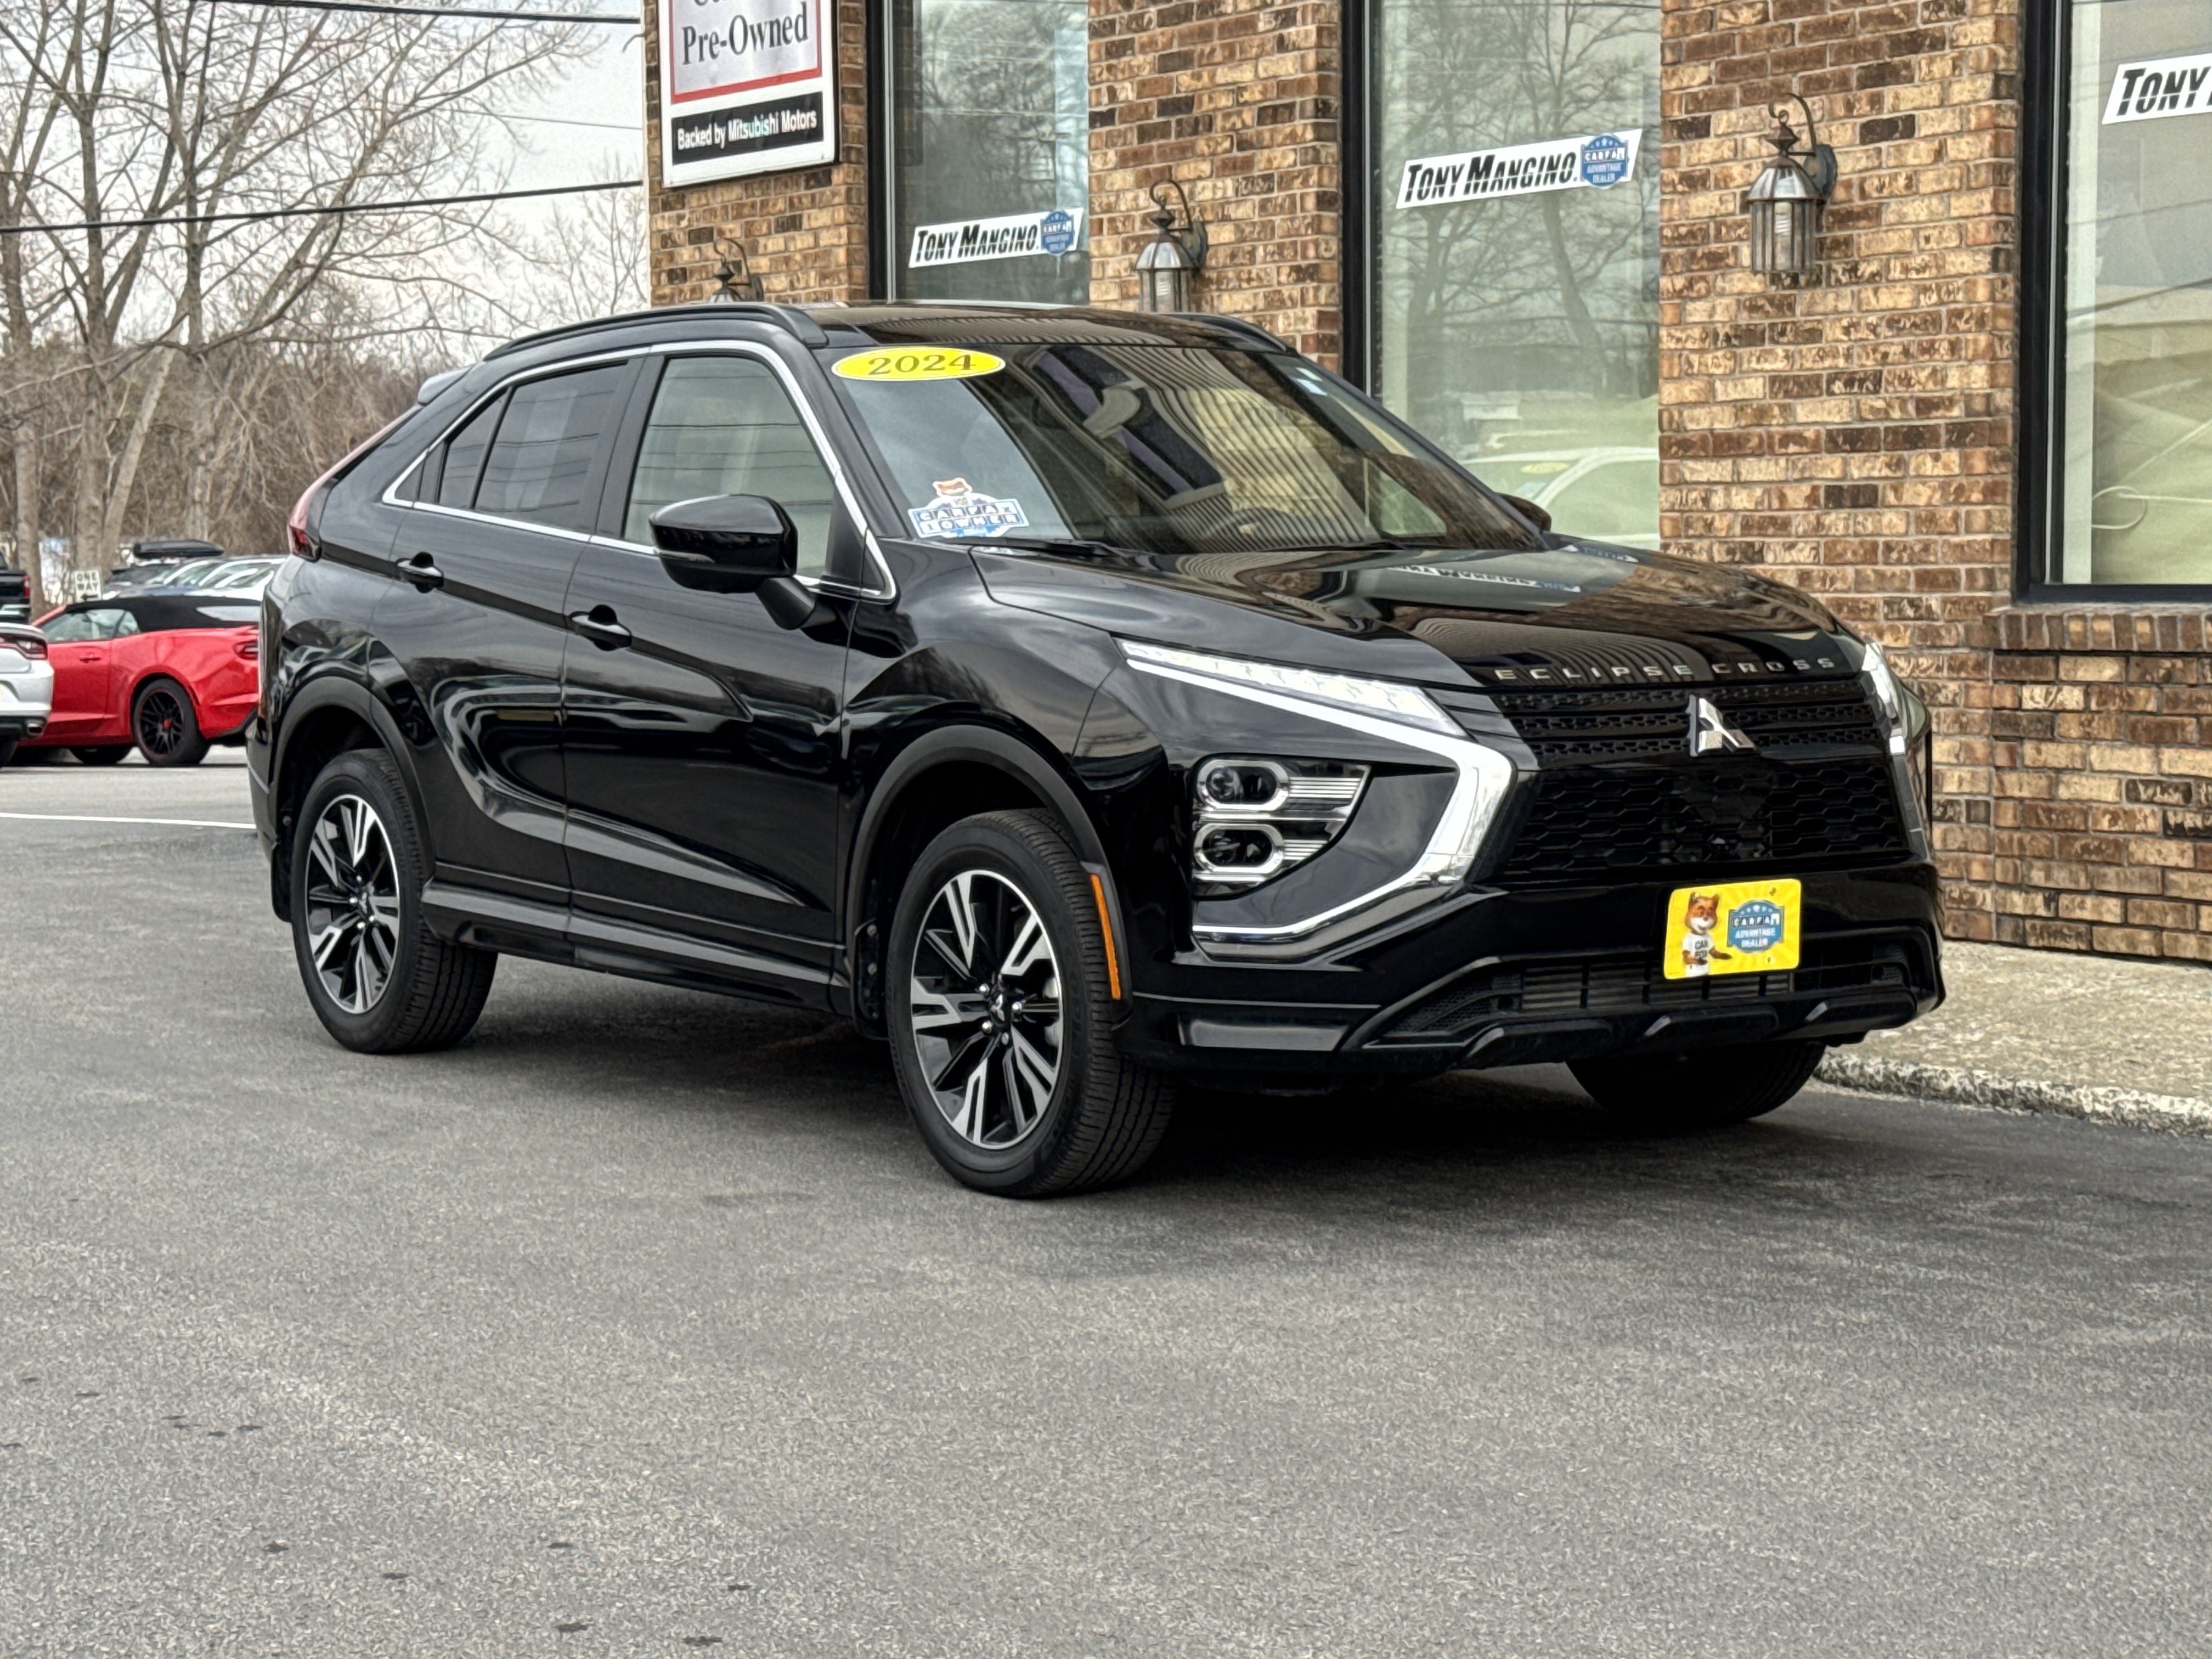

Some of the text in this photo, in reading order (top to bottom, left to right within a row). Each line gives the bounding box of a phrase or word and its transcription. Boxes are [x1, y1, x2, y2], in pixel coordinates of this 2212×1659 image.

[682, 1, 808, 65] Pre-Owned
[2117, 65, 2211, 117] TONY
[678, 109, 817, 150] Backed by Mitsubishi Motors
[1404, 163, 1465, 202] TONY
[915, 230, 959, 262] TONY
[868, 354, 977, 376] 2024
[919, 504, 1012, 521] CARFAX
[940, 514, 1019, 530] OWNER
[77, 572, 98, 582] ONE
[77, 583, 99, 591] WAY
[1494, 664, 1694, 681] ECLIPSE
[1711, 658, 1835, 674] CROSS
